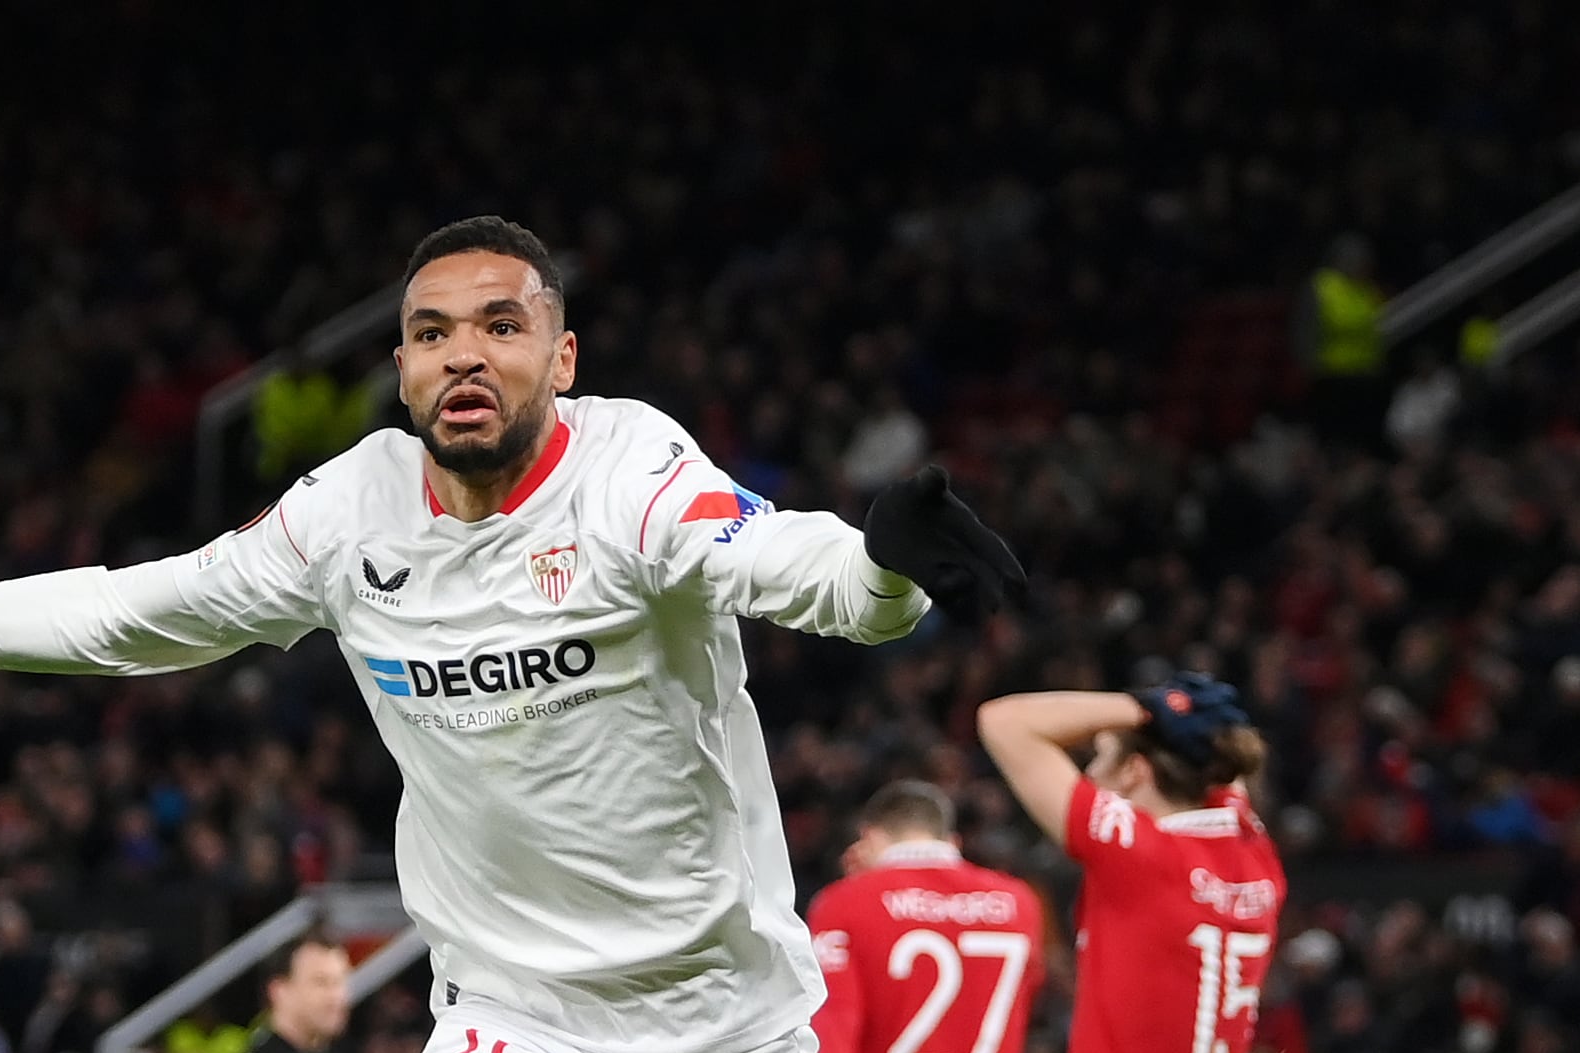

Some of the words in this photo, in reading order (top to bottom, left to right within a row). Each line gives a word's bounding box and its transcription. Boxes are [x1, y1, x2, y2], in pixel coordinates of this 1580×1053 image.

[358, 589, 402, 608] CASTORE
[407, 638, 596, 698] DEGIRO
[446, 706, 519, 729] LEADING
[524, 688, 598, 721] BROKER
